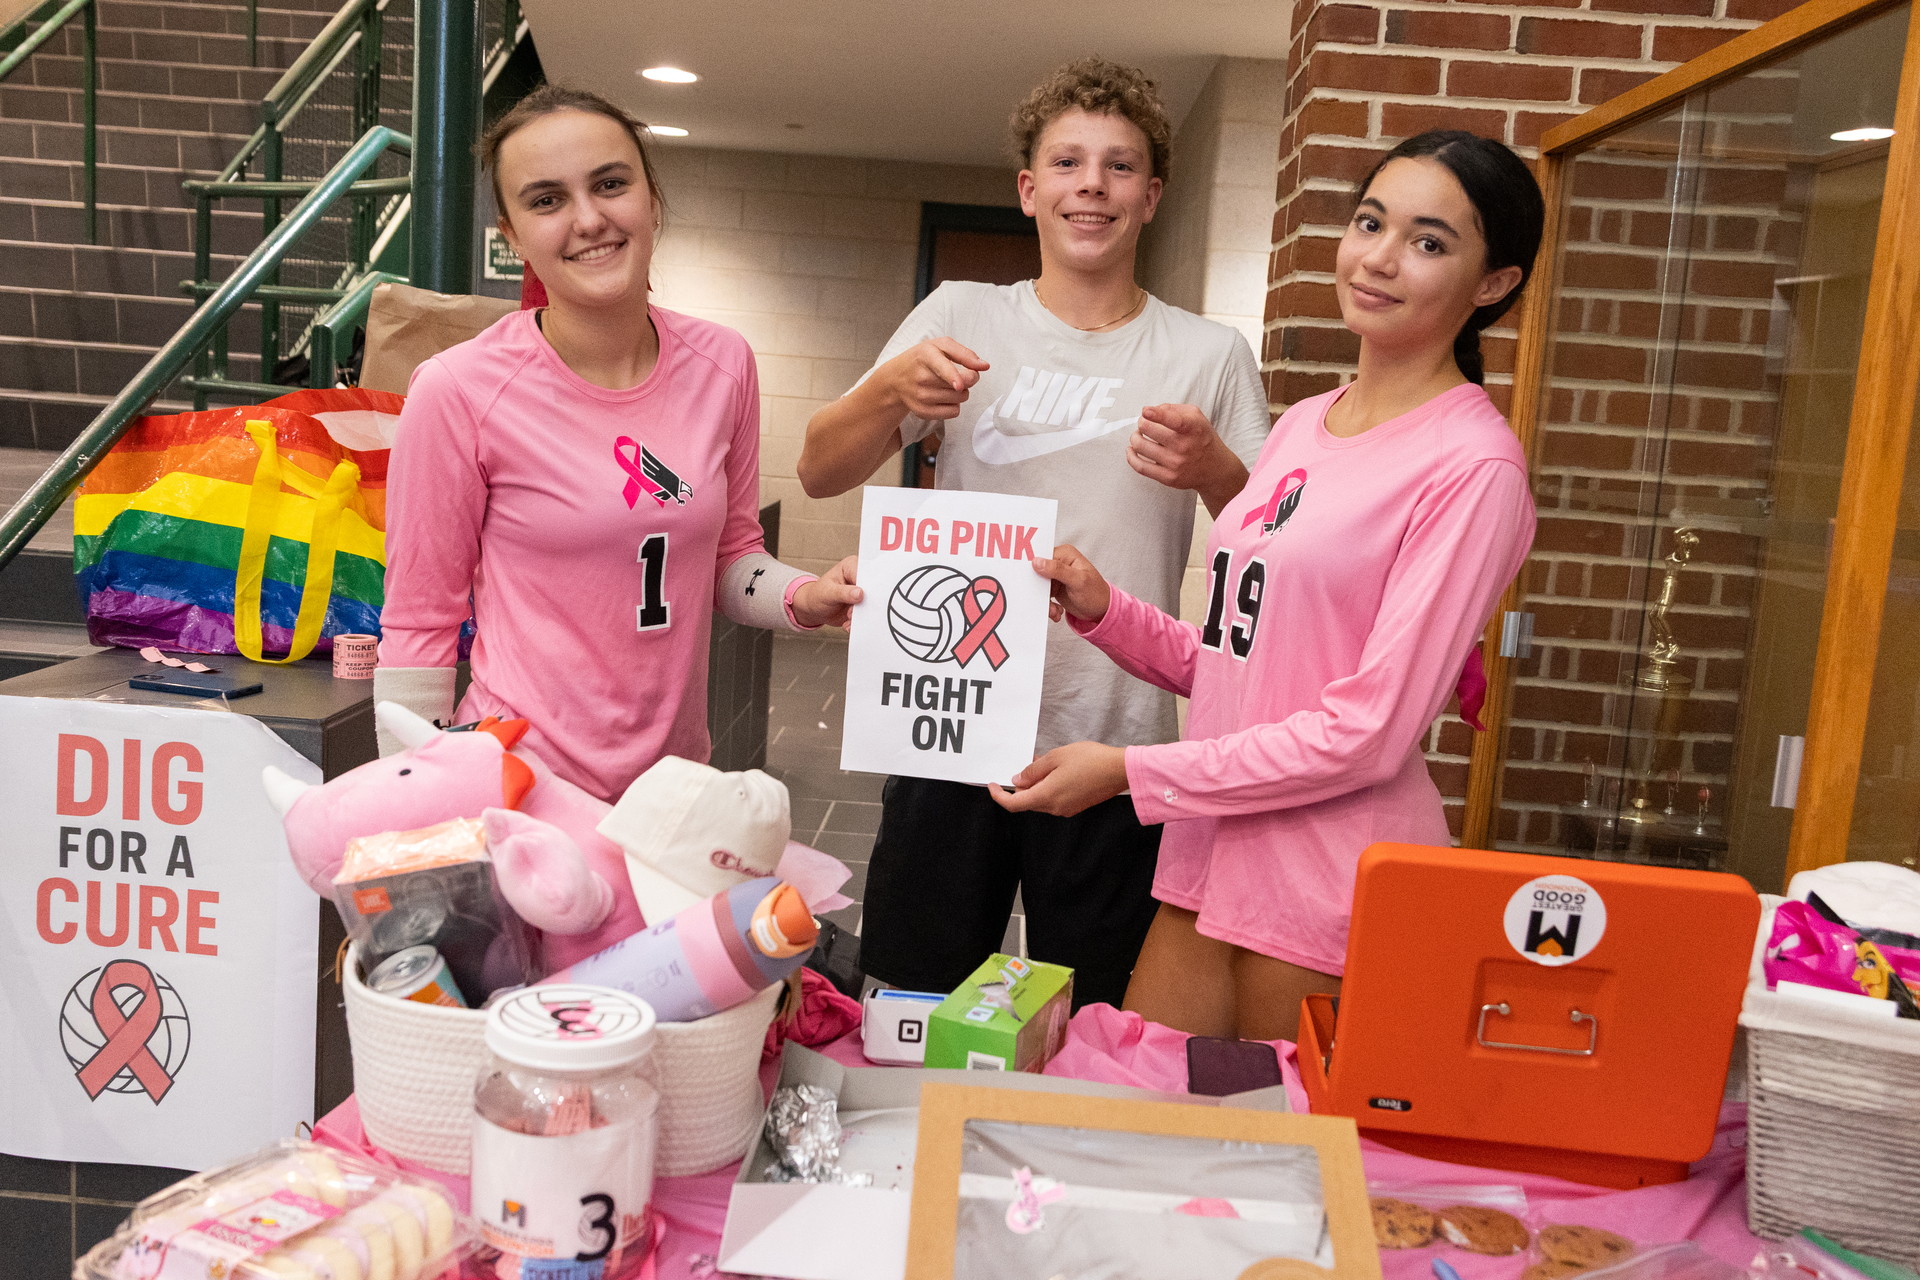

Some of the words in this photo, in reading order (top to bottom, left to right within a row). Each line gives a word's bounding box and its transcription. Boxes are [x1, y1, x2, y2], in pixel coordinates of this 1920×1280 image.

[998, 365, 1125, 429] NIKE
[879, 515, 940, 555] DIG
[949, 520, 1039, 562] PINK
[636, 532, 671, 632] 1
[1200, 546, 1267, 663] 19
[881, 671, 993, 715] FIGHT
[911, 714, 966, 754] ON
[56, 733, 204, 826] DIG
[58, 826, 147, 874] FOR
[165, 835, 195, 878] A
[36, 876, 220, 957] CURE
[1532, 901, 1584, 912] GREATEST
[1533, 890, 1587, 905] GOOD
[575, 1192, 617, 1262] 3
